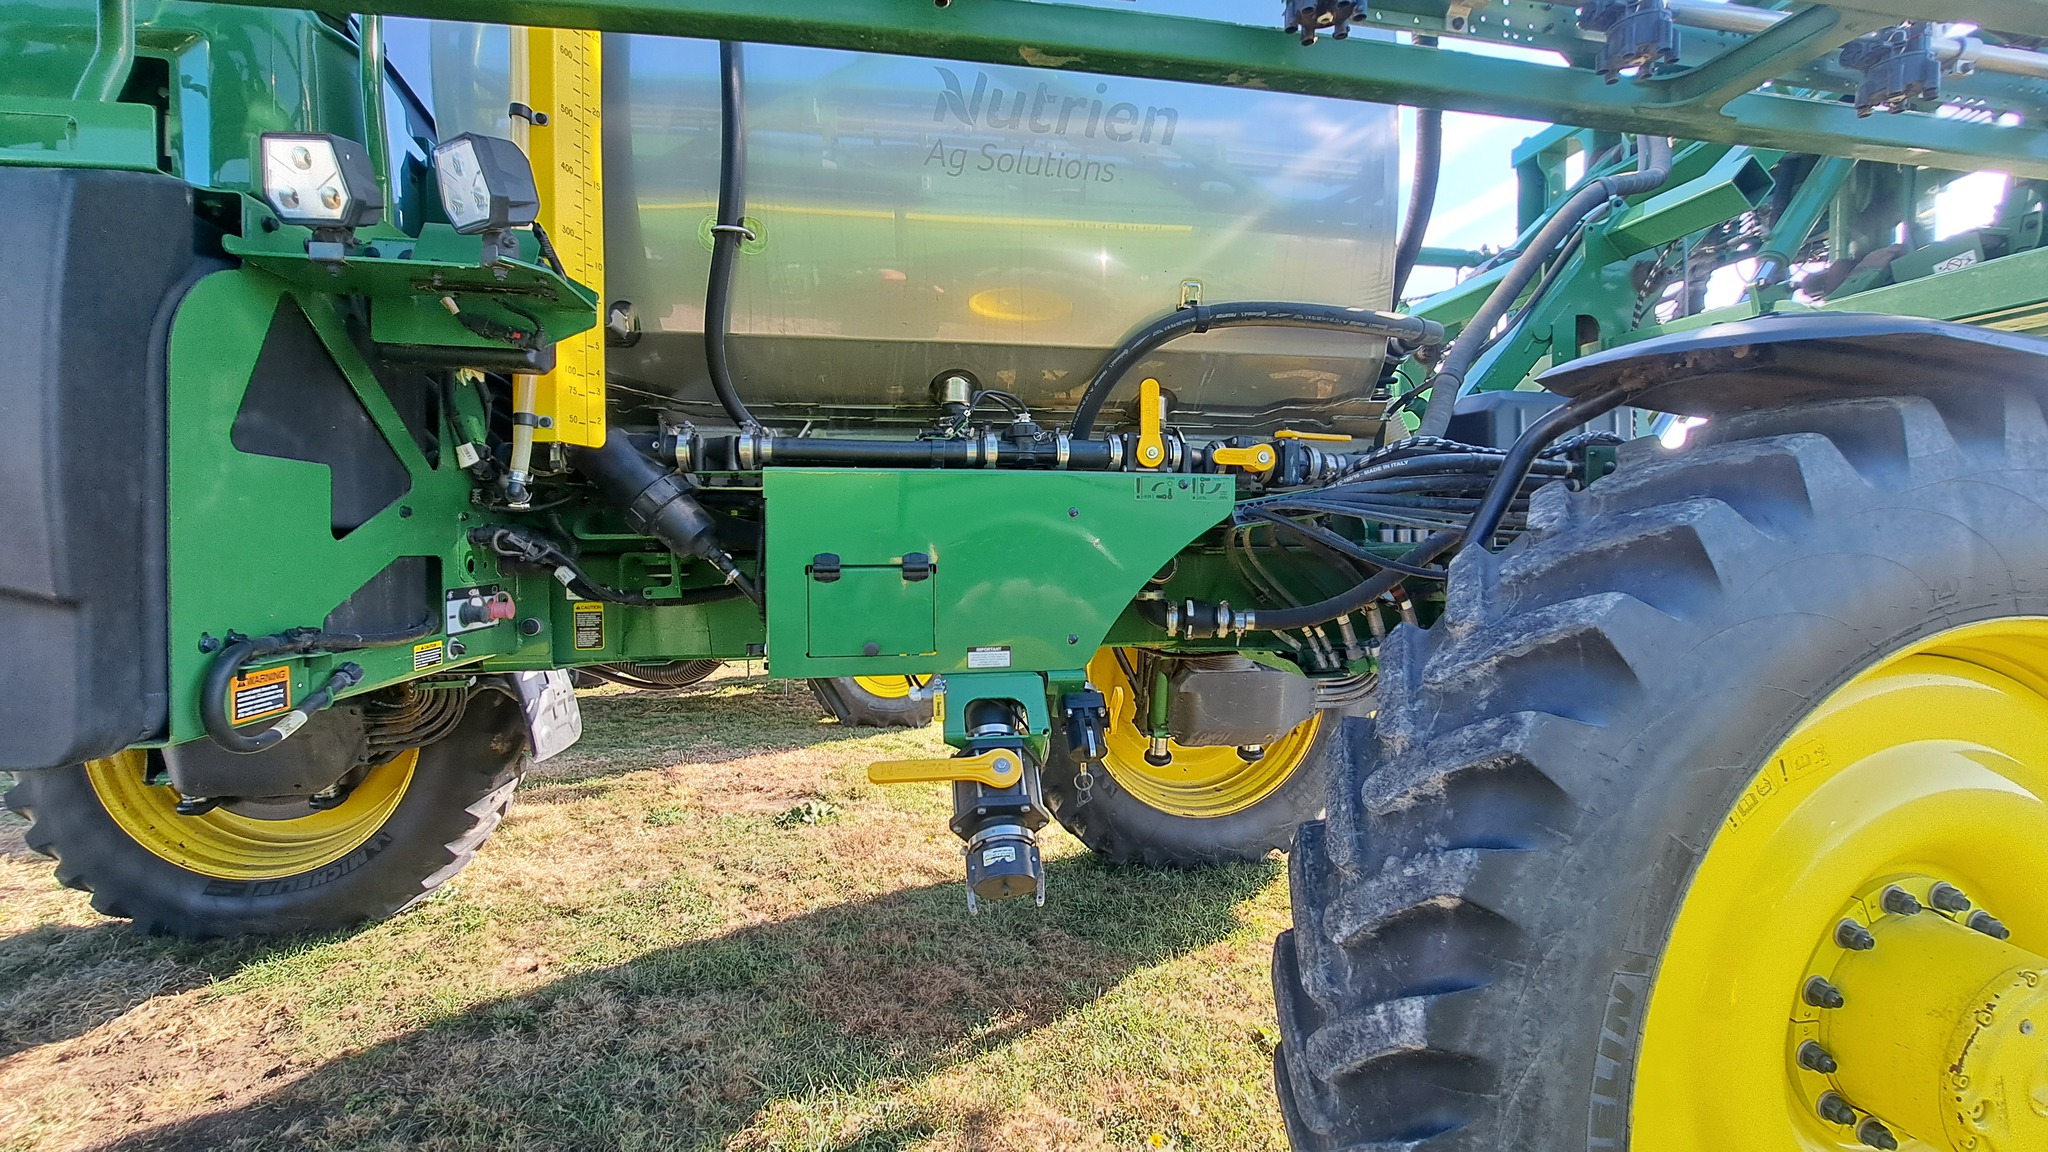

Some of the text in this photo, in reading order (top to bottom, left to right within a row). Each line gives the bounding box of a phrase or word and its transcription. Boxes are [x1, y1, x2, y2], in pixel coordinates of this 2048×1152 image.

[560, 45, 573, 59] 600
[560, 104, 573, 117] 500
[933, 66, 1179, 146] Nutrien
[592, 107, 600, 118] 20
[924, 139, 1116, 183] Ag Solutions
[561, 162, 573, 174] 400
[593, 181, 601, 191] 15
[562, 224, 575, 237] 300
[595, 262, 603, 272] 10
[595, 341, 600, 350] 5
[565, 365, 577, 375] 100
[569, 386, 578, 396] 75
[596, 388, 601, 396] 3
[569, 415, 578, 424] 50
[597, 417, 602, 425] 2
[1364, 465, 1382, 475] MADE
[1383, 462, 1391, 470] IN
[1391, 459, 1409, 468] ITALY
[246, 669, 286, 685] WARNING
[253, 849, 369, 897] MICHELIN
[1587, 981, 1636, 1152] ELIN
